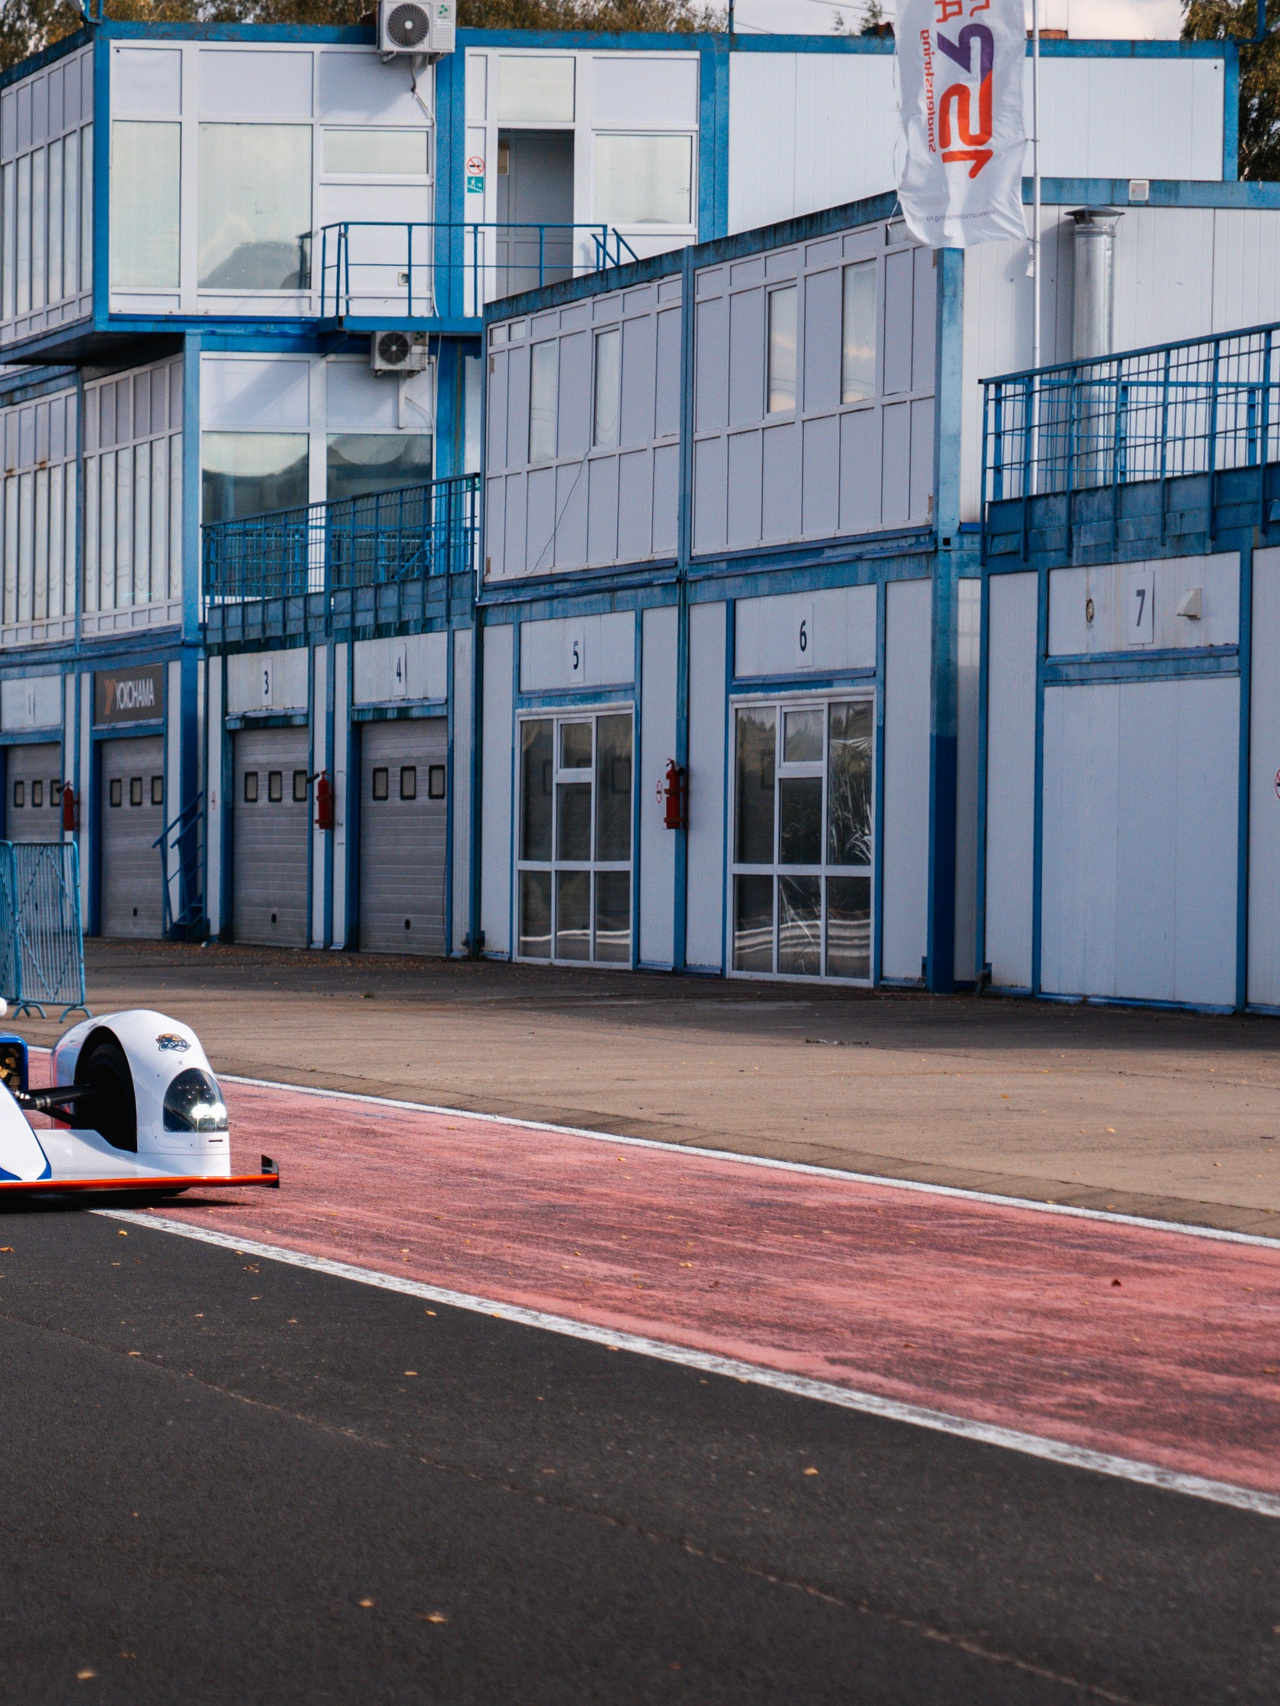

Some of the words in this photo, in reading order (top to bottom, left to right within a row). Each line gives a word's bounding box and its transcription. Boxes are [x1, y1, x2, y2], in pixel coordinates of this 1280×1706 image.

[1136, 589, 1146, 627] 7
[799, 619, 808, 652] 6
[396, 656, 402, 683] 4
[573, 640, 579, 670] 5
[115, 677, 155, 710] YOKOHAMA
[263, 670, 269, 695] 3
